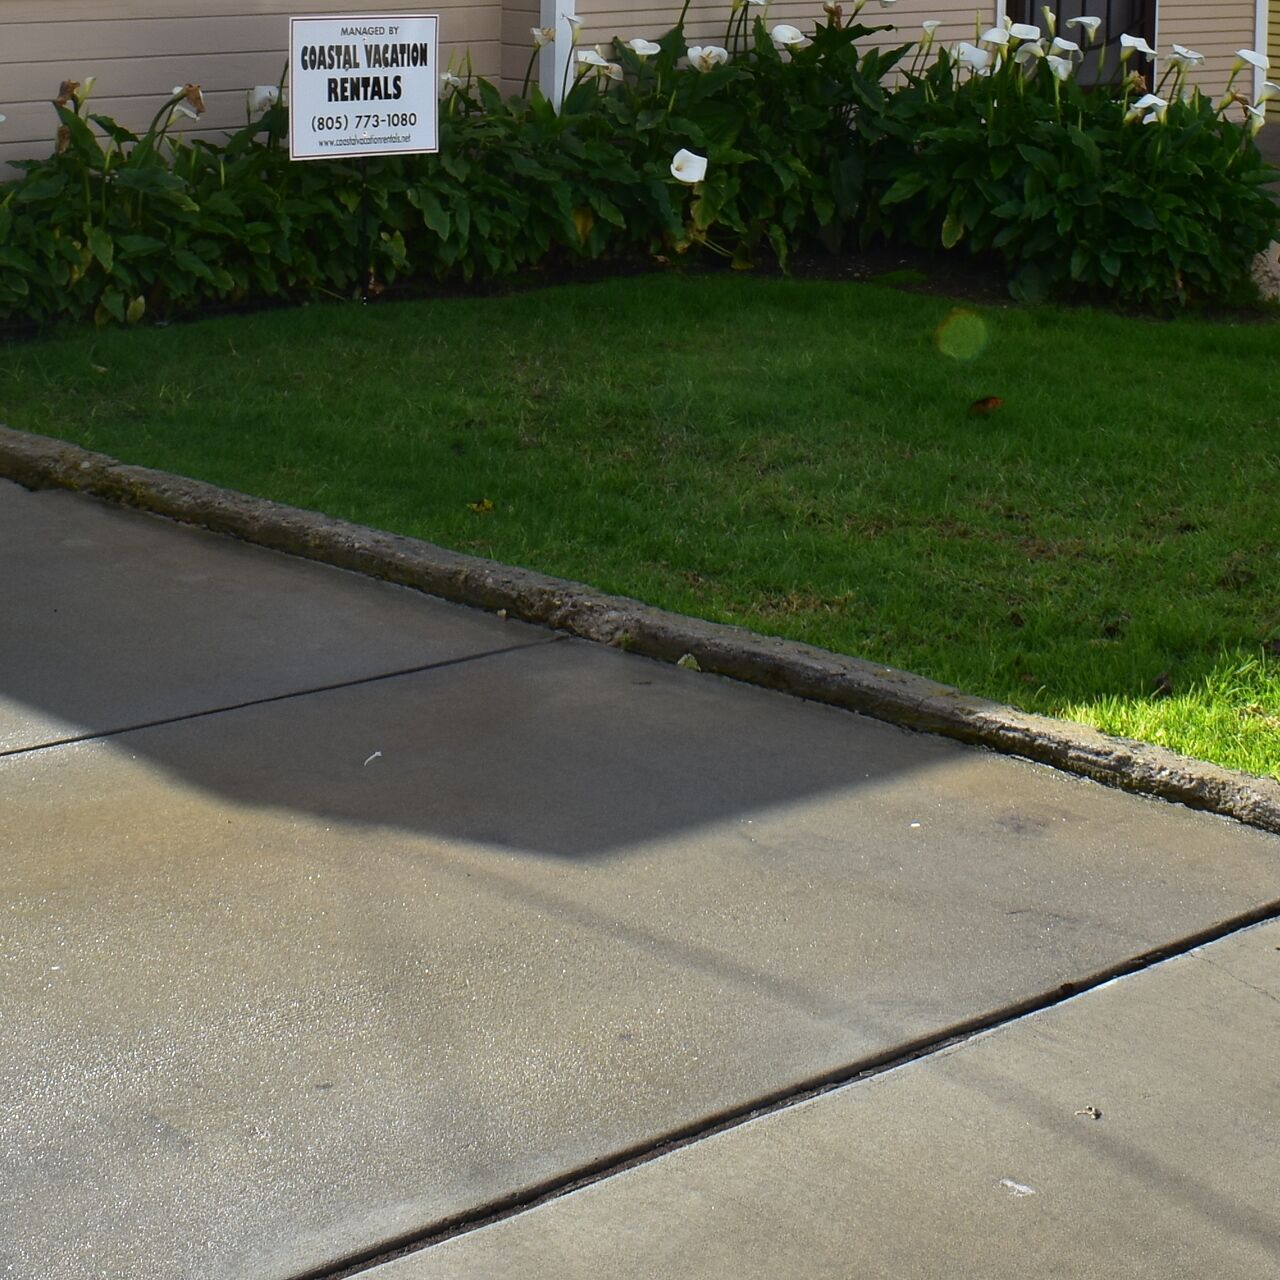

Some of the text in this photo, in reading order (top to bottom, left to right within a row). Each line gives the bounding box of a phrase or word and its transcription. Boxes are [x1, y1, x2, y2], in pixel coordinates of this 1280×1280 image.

[340, 26, 399, 36] MANAGED BY
[301, 43, 428, 70] COASTAL VACATION
[327, 75, 402, 102] RENTALS
[311, 113, 417, 132] (805) 773-1080
[318, 133, 411, 147] www.coastalvacationrentals.net
